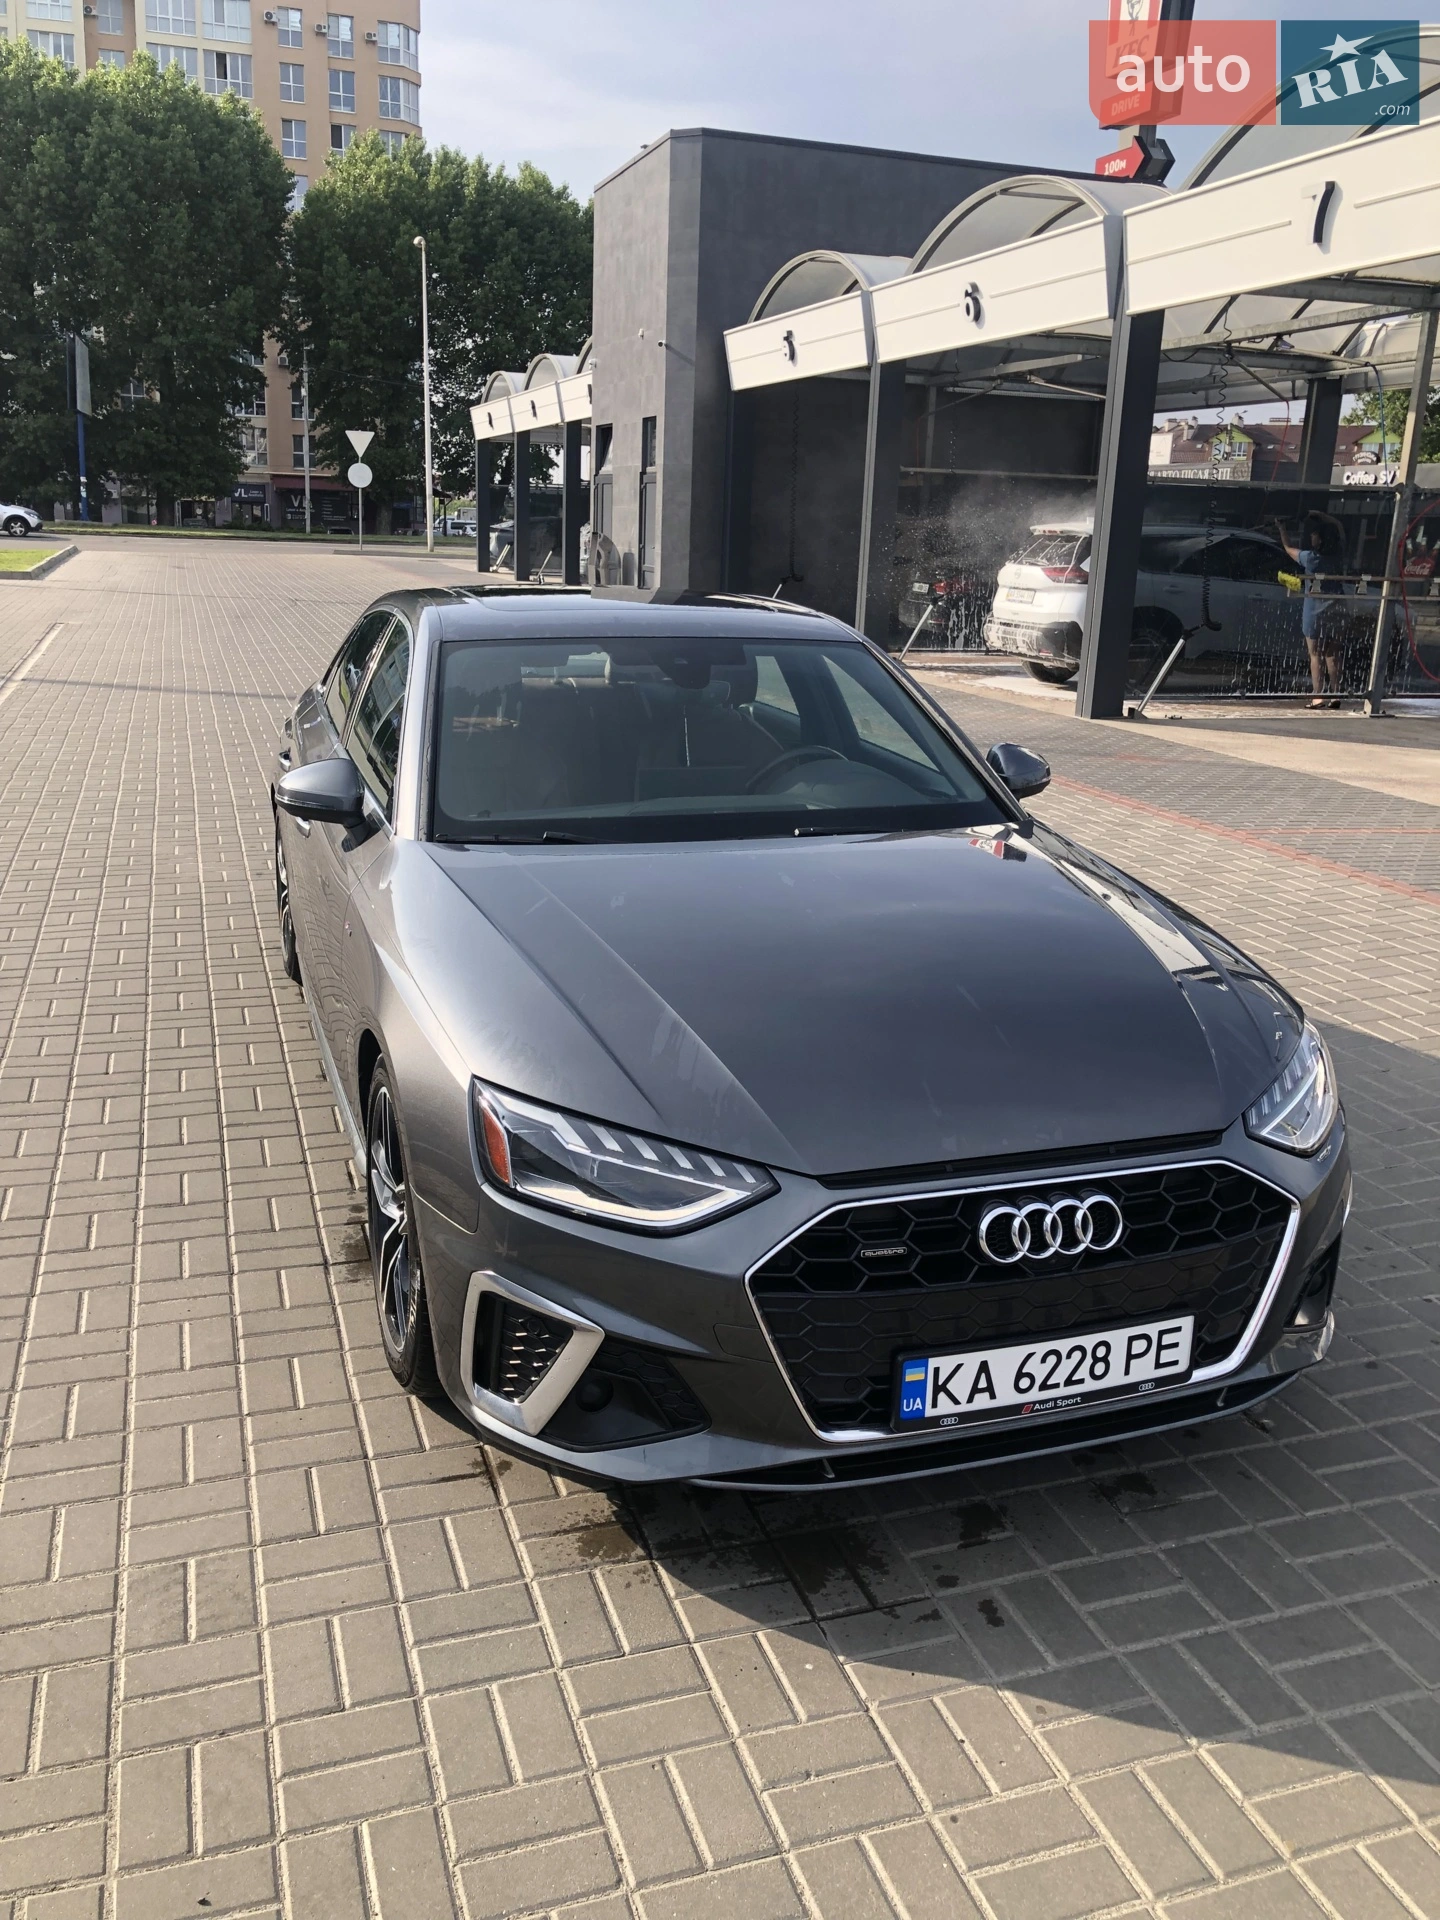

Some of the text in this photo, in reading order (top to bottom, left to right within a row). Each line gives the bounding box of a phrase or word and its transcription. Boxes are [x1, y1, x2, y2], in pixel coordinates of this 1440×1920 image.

[1111, 94, 1140, 116] DRIVE
[1343, 471, 1376, 485] Coffee
[864, 1249, 905, 1257] quattro
[930, 1325, 1183, 1410] KA 6228 PE
[903, 1397, 923, 1412] UA
[1033, 1396, 1082, 1411] Audi Sport
